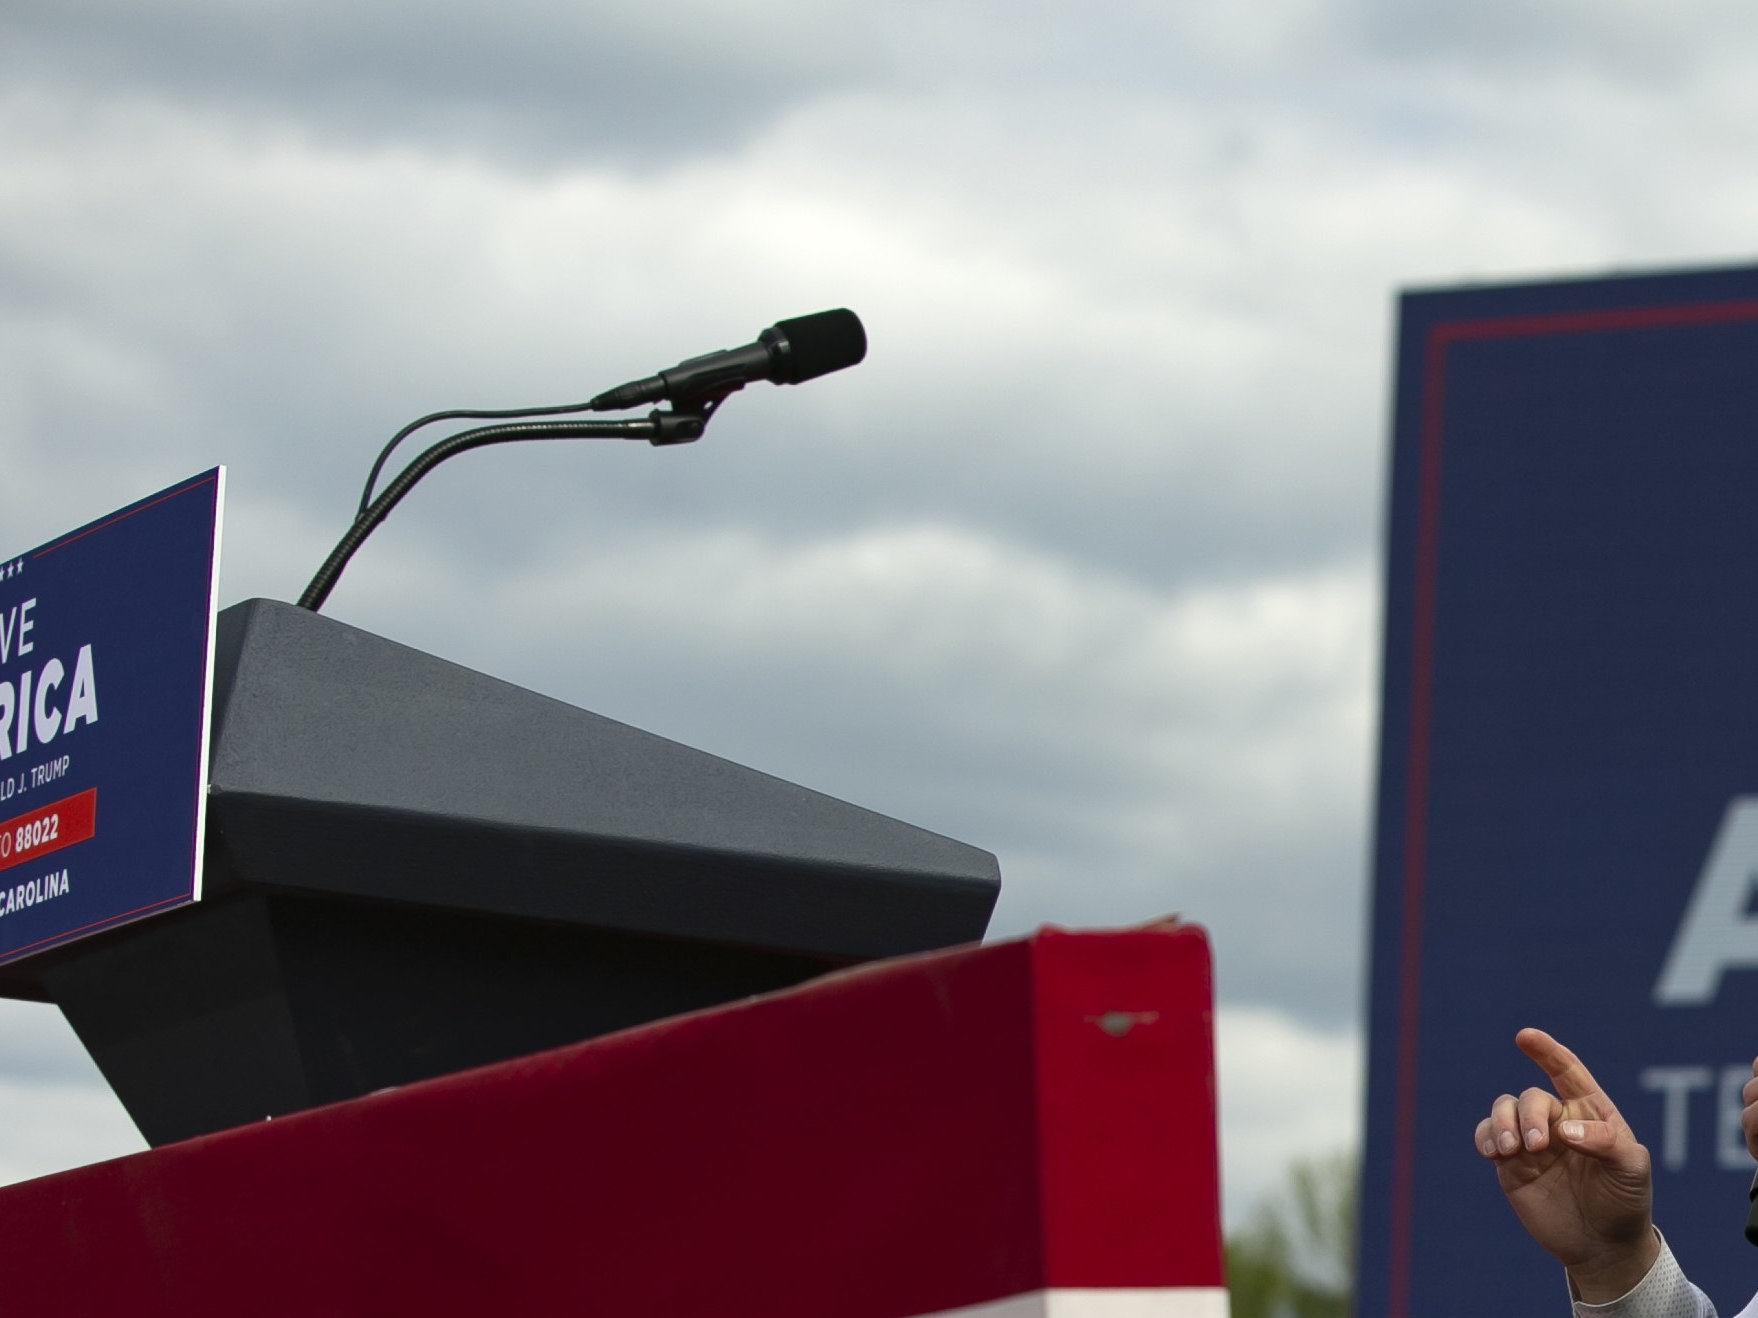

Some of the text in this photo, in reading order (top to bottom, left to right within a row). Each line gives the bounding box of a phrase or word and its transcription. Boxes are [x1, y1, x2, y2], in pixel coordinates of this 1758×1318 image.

[31, 755, 70, 789] TRUMP
[0, 813, 59, 859] O 88022
